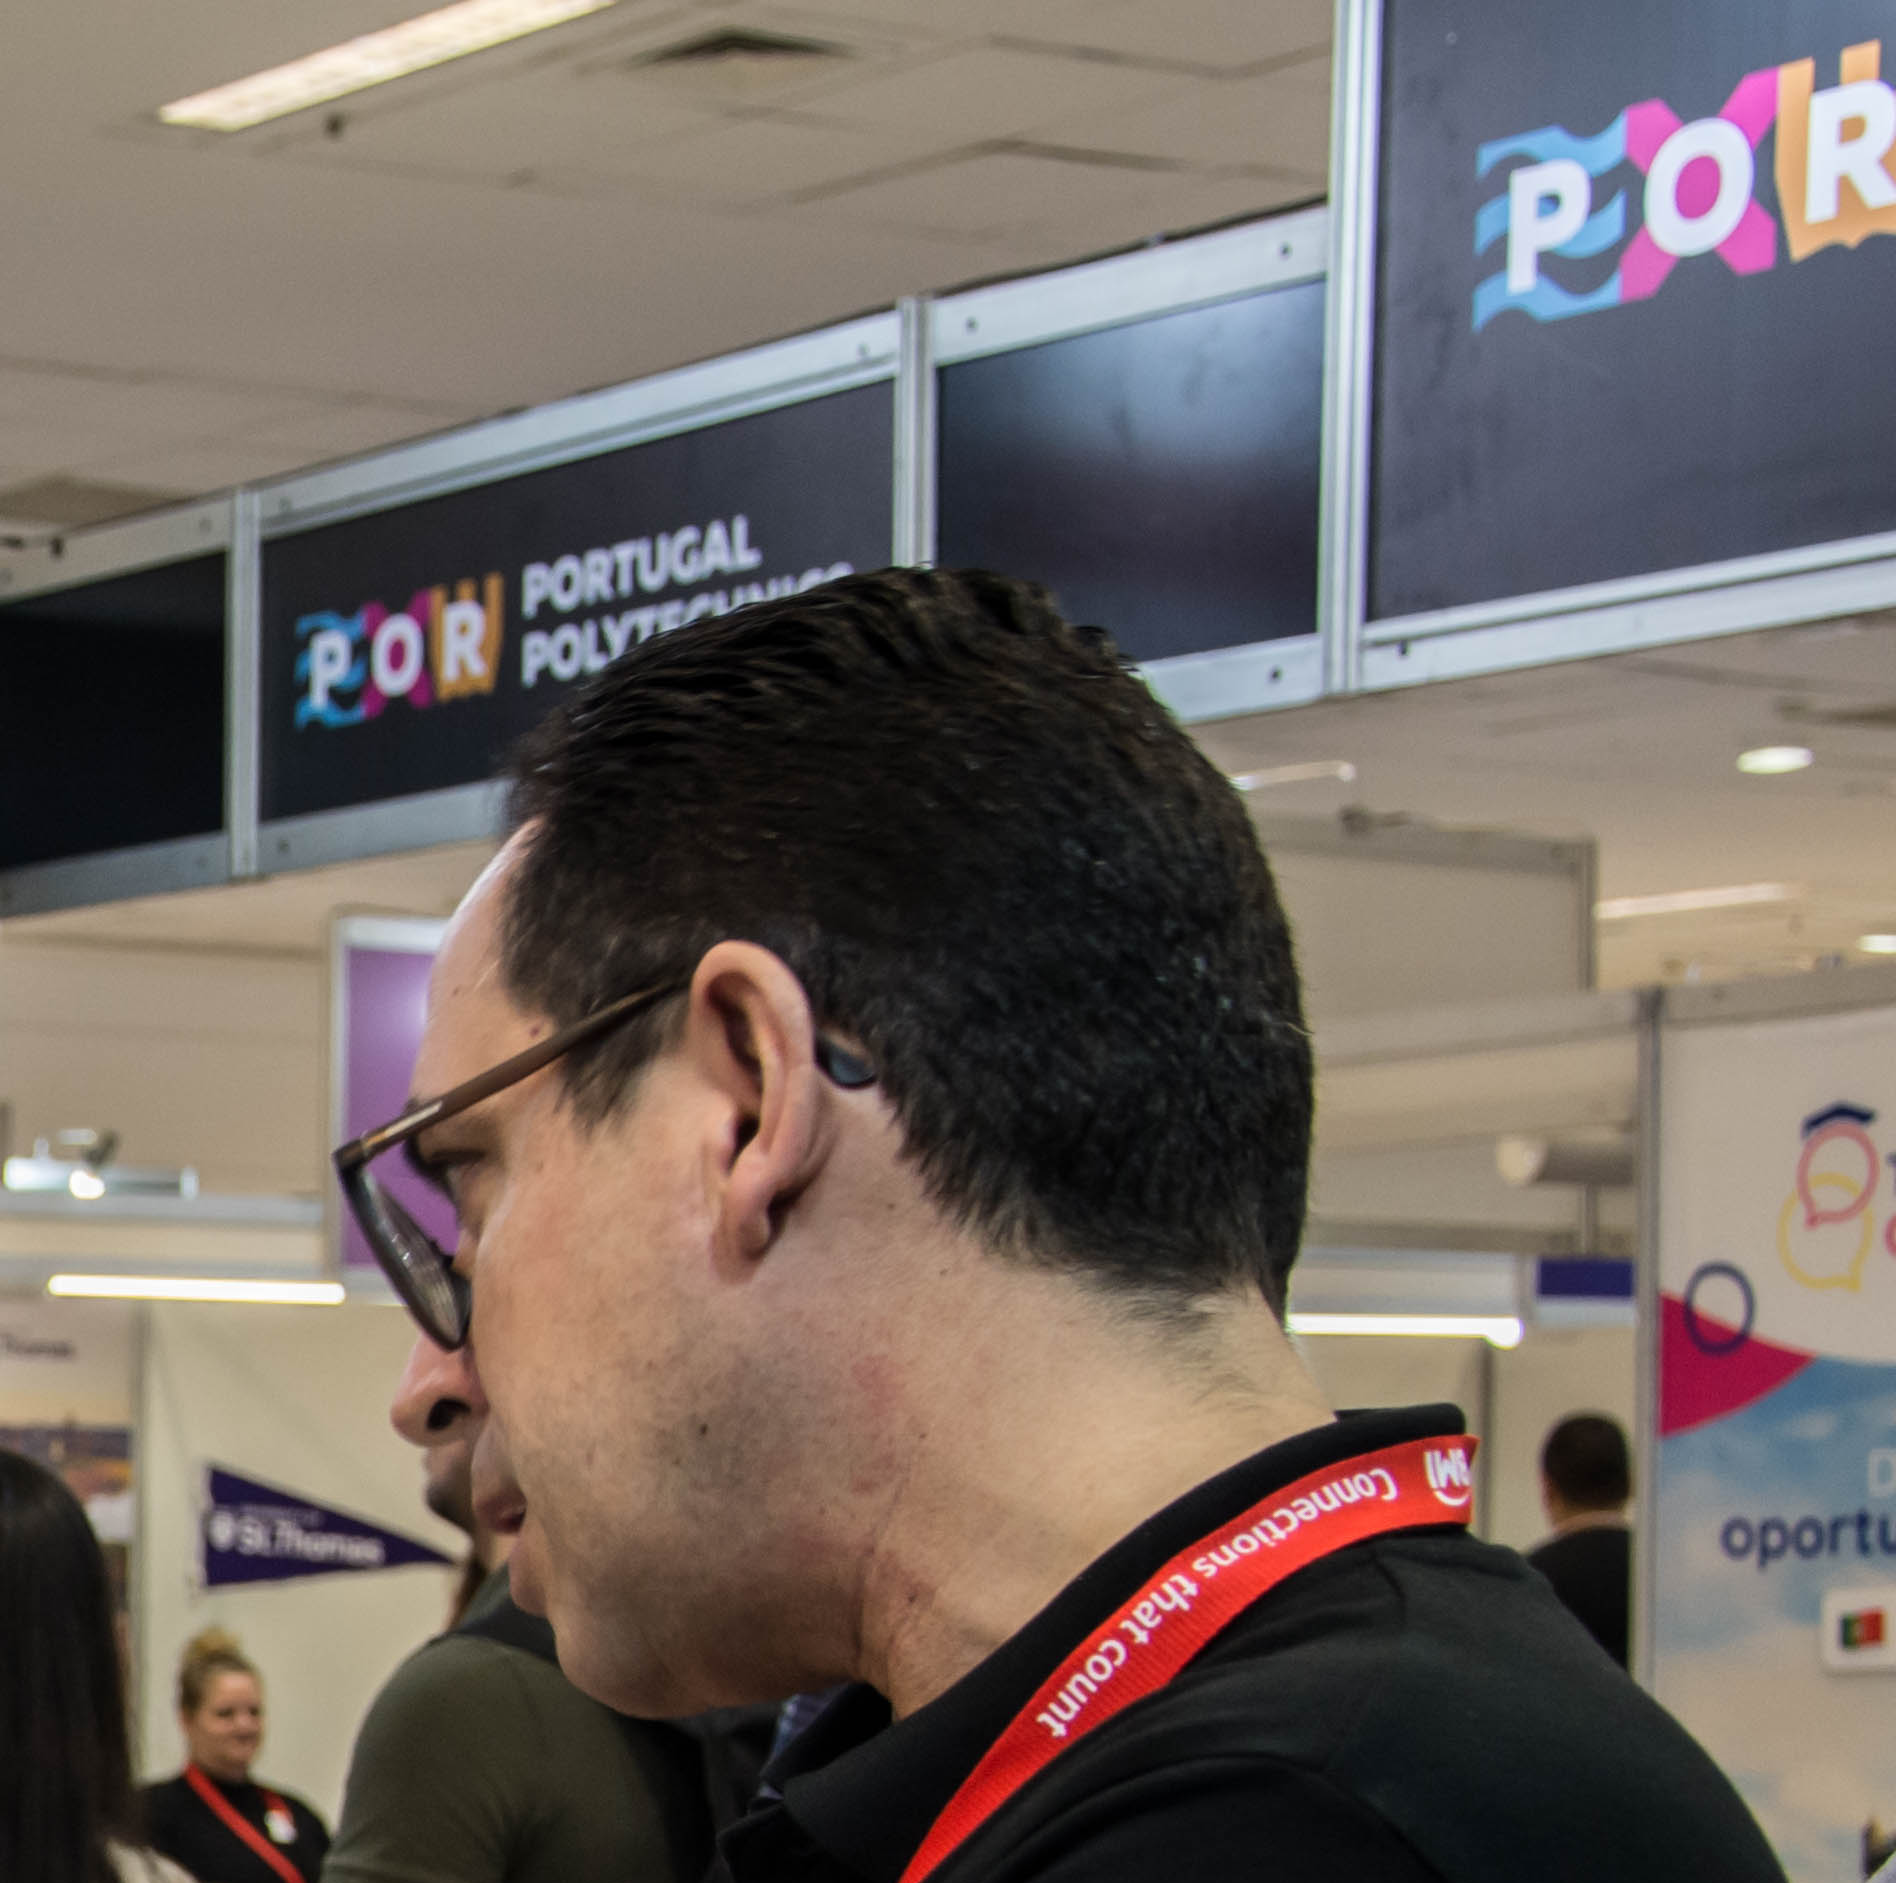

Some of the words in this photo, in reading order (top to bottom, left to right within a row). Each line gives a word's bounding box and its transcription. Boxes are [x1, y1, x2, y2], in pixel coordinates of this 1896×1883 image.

[521, 514, 763, 620] PORTUGAL
[1191, 1465, 1399, 1580] Connections
[1126, 1572, 1201, 1645] that
[1034, 1640, 1130, 1739] count
